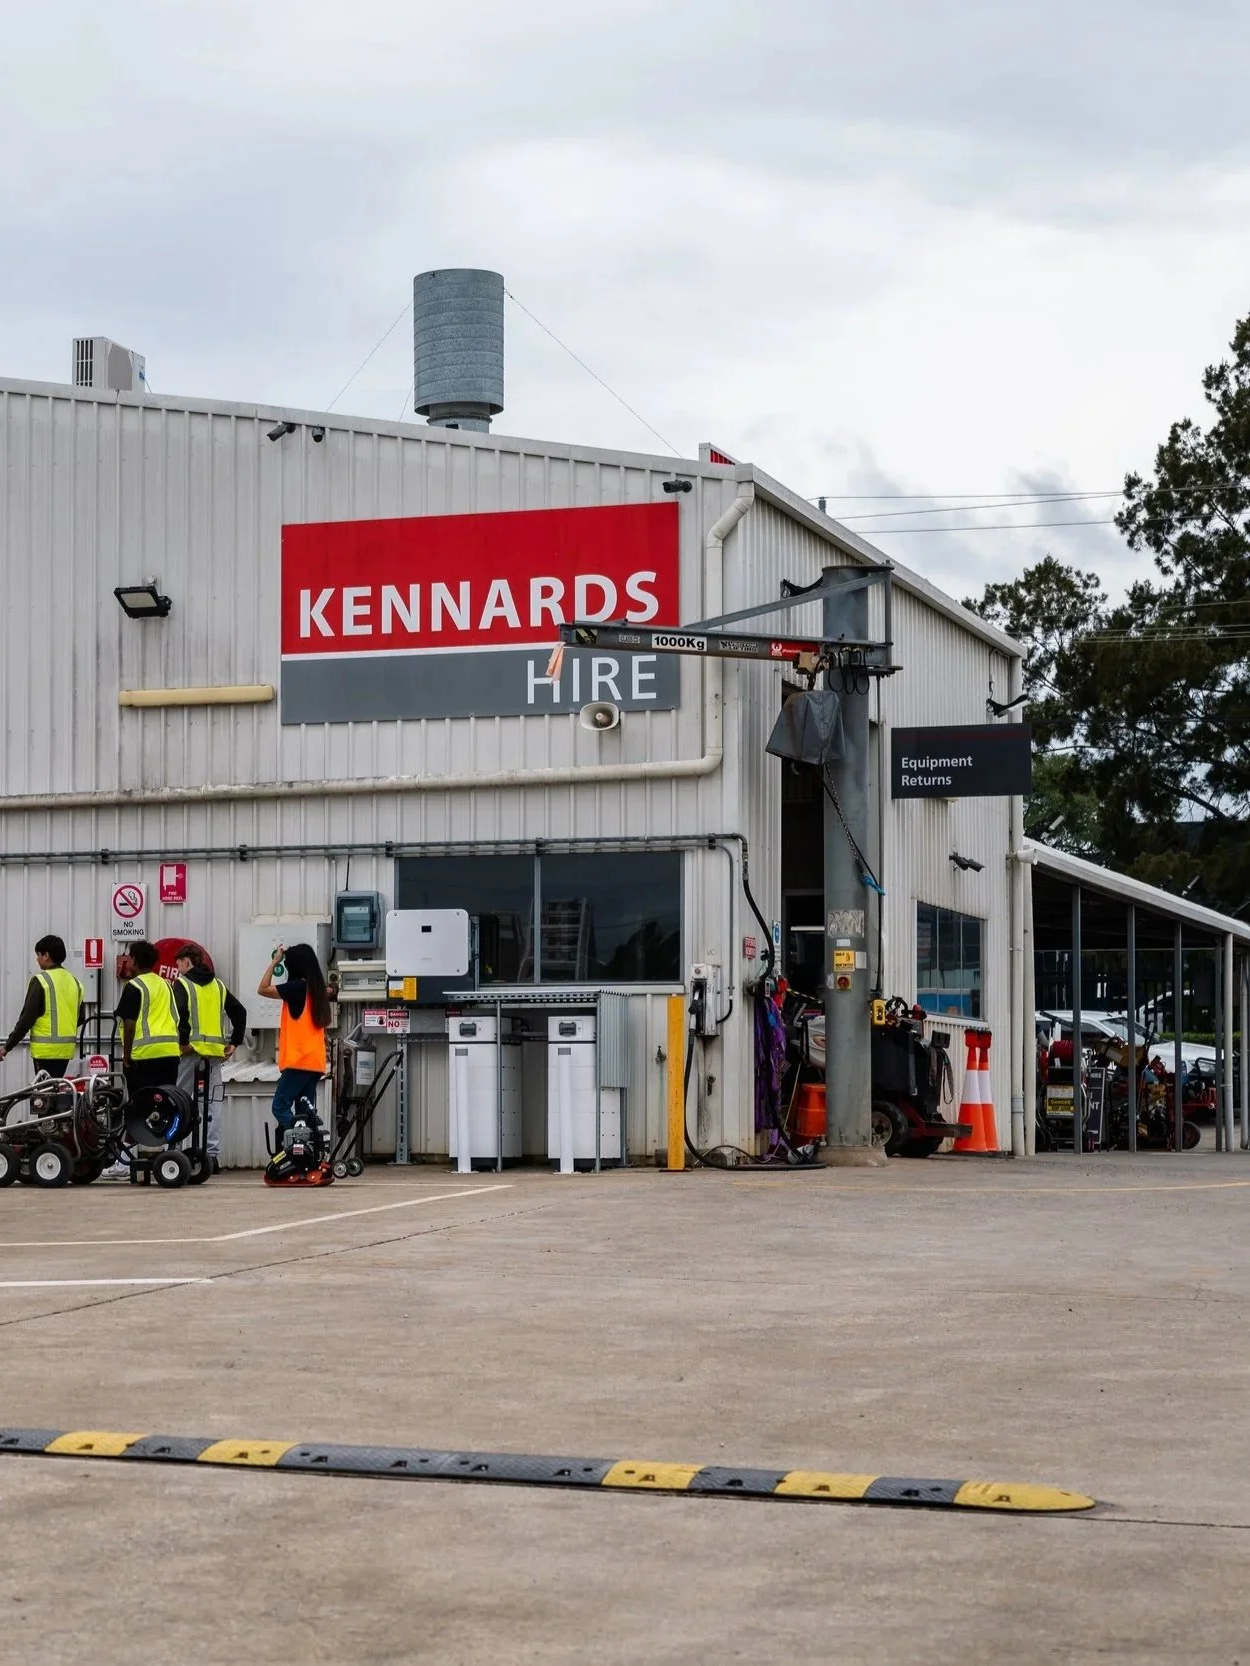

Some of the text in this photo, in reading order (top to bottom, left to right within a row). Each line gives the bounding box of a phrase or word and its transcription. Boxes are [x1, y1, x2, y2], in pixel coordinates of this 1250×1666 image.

[298, 570, 660, 638] KENNARDS
[654, 636, 705, 651] 1000Kg
[527, 654, 658, 704] HIRE
[901, 756, 973, 771] Equipment
[901, 775, 952, 787] Returns
[159, 965, 183, 979] FIR
